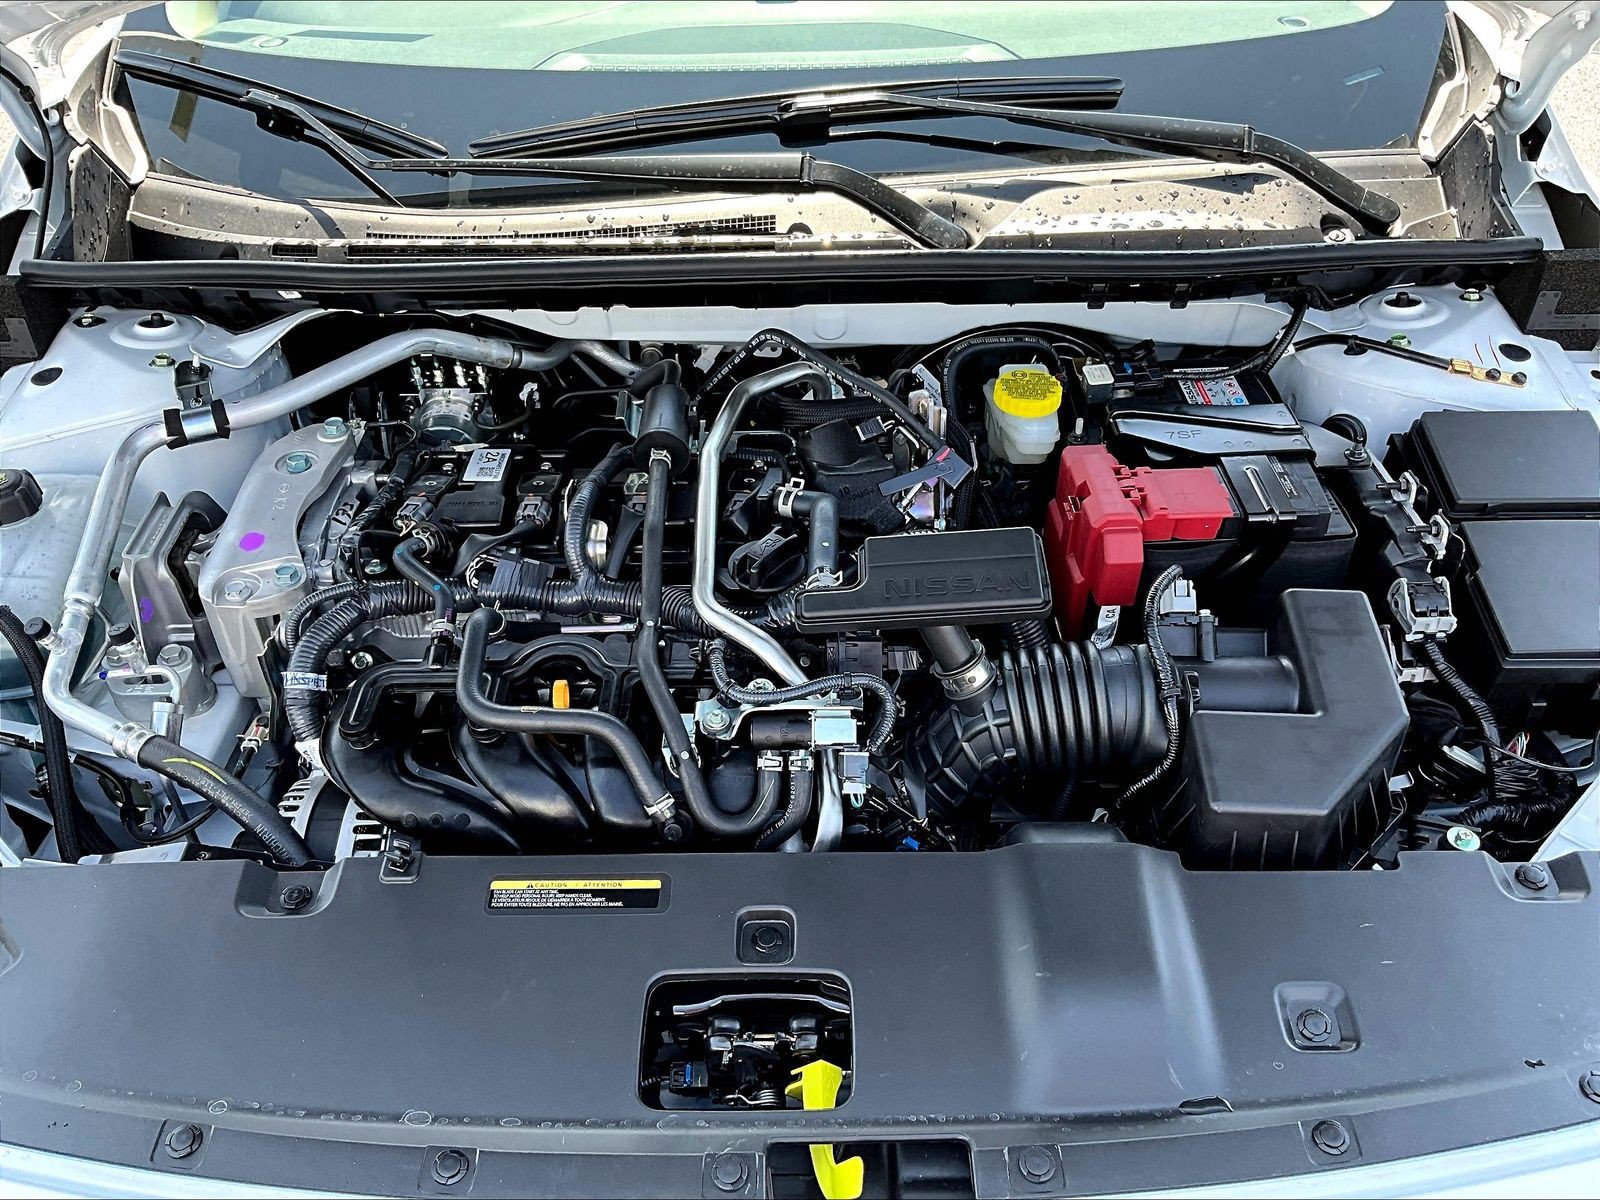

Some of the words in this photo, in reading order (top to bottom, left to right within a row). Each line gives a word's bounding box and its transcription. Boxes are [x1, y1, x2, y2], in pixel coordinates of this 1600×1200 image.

[1164, 430, 1202, 440] 7SF
[482, 452, 500, 464] 2A
[884, 571, 1032, 598] NISSAN
